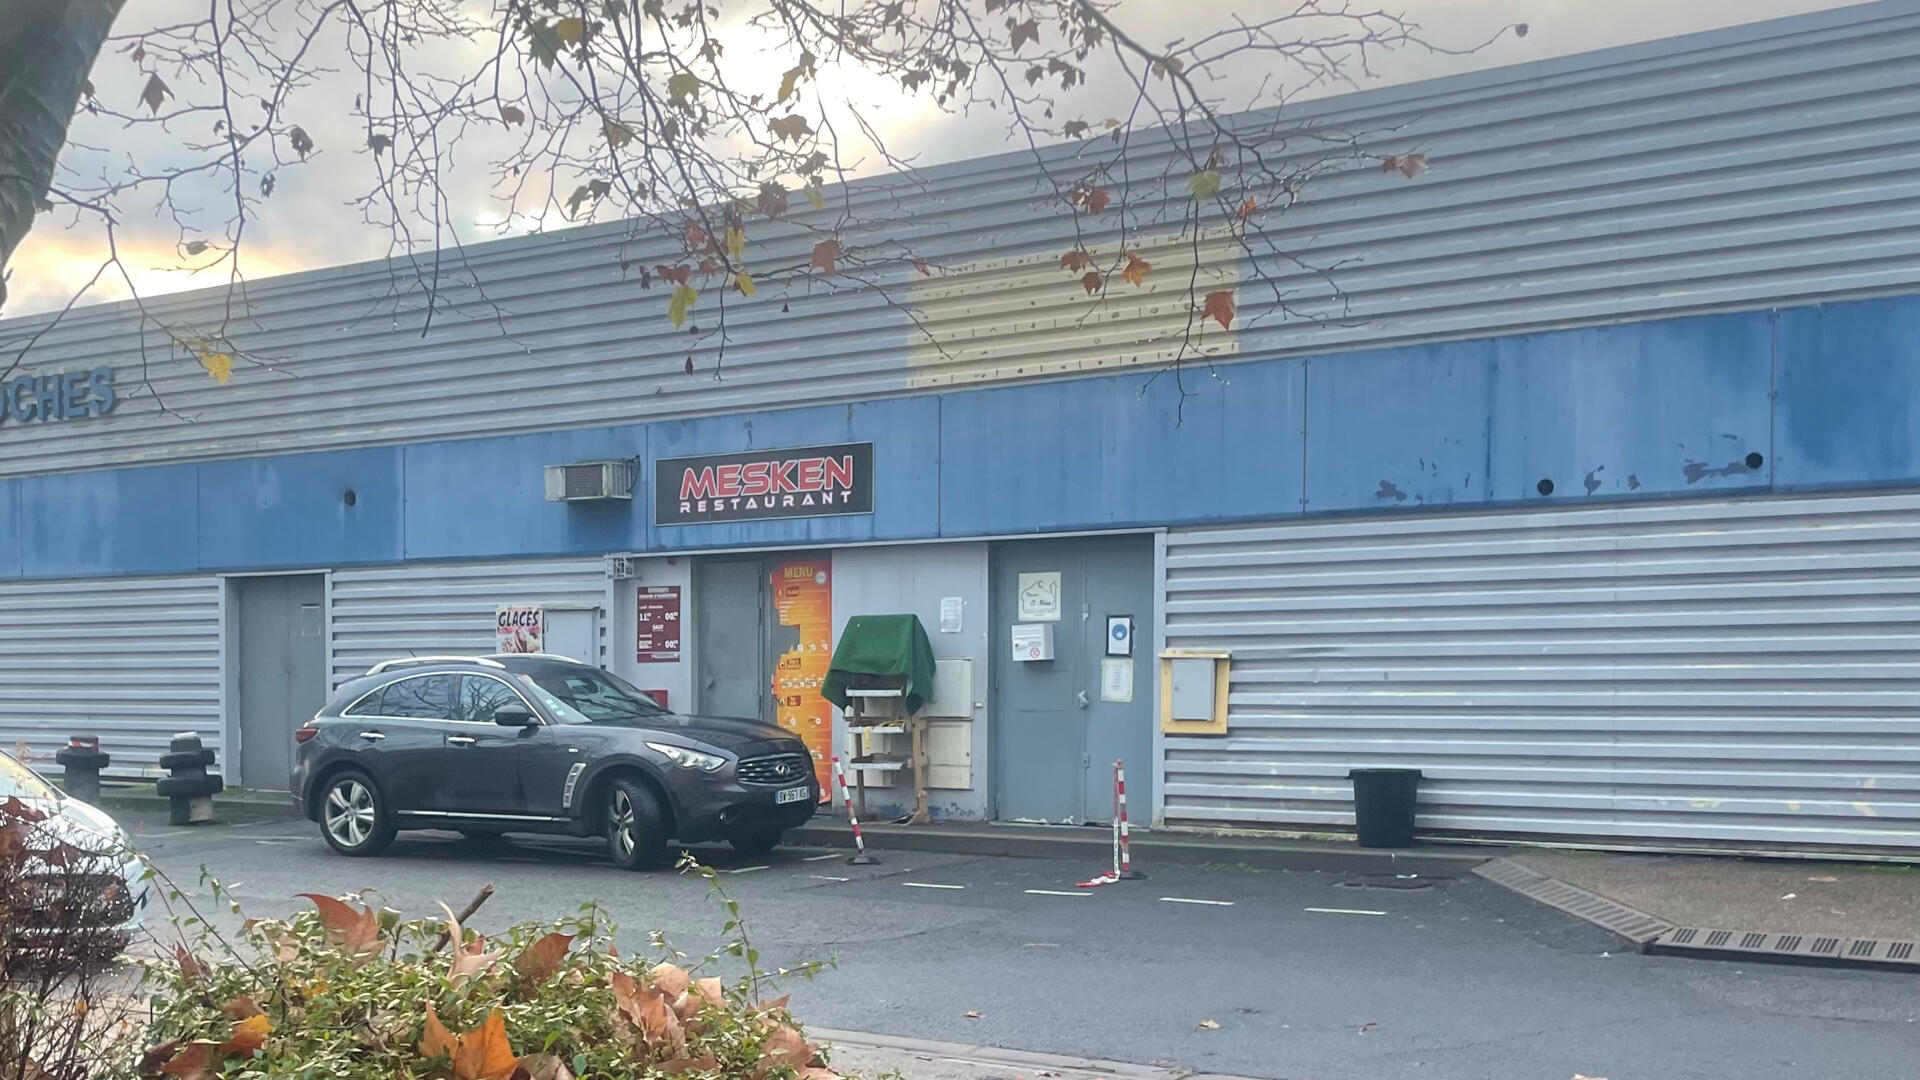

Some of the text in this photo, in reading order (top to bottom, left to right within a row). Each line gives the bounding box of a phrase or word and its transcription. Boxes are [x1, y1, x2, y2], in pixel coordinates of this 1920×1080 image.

[0, 365, 115, 422] CHES
[680, 455, 853, 500] MESKEN
[680, 491, 852, 514] RESTAURANT
[784, 565, 813, 579] MENU
[498, 610, 539, 628] GLACES
